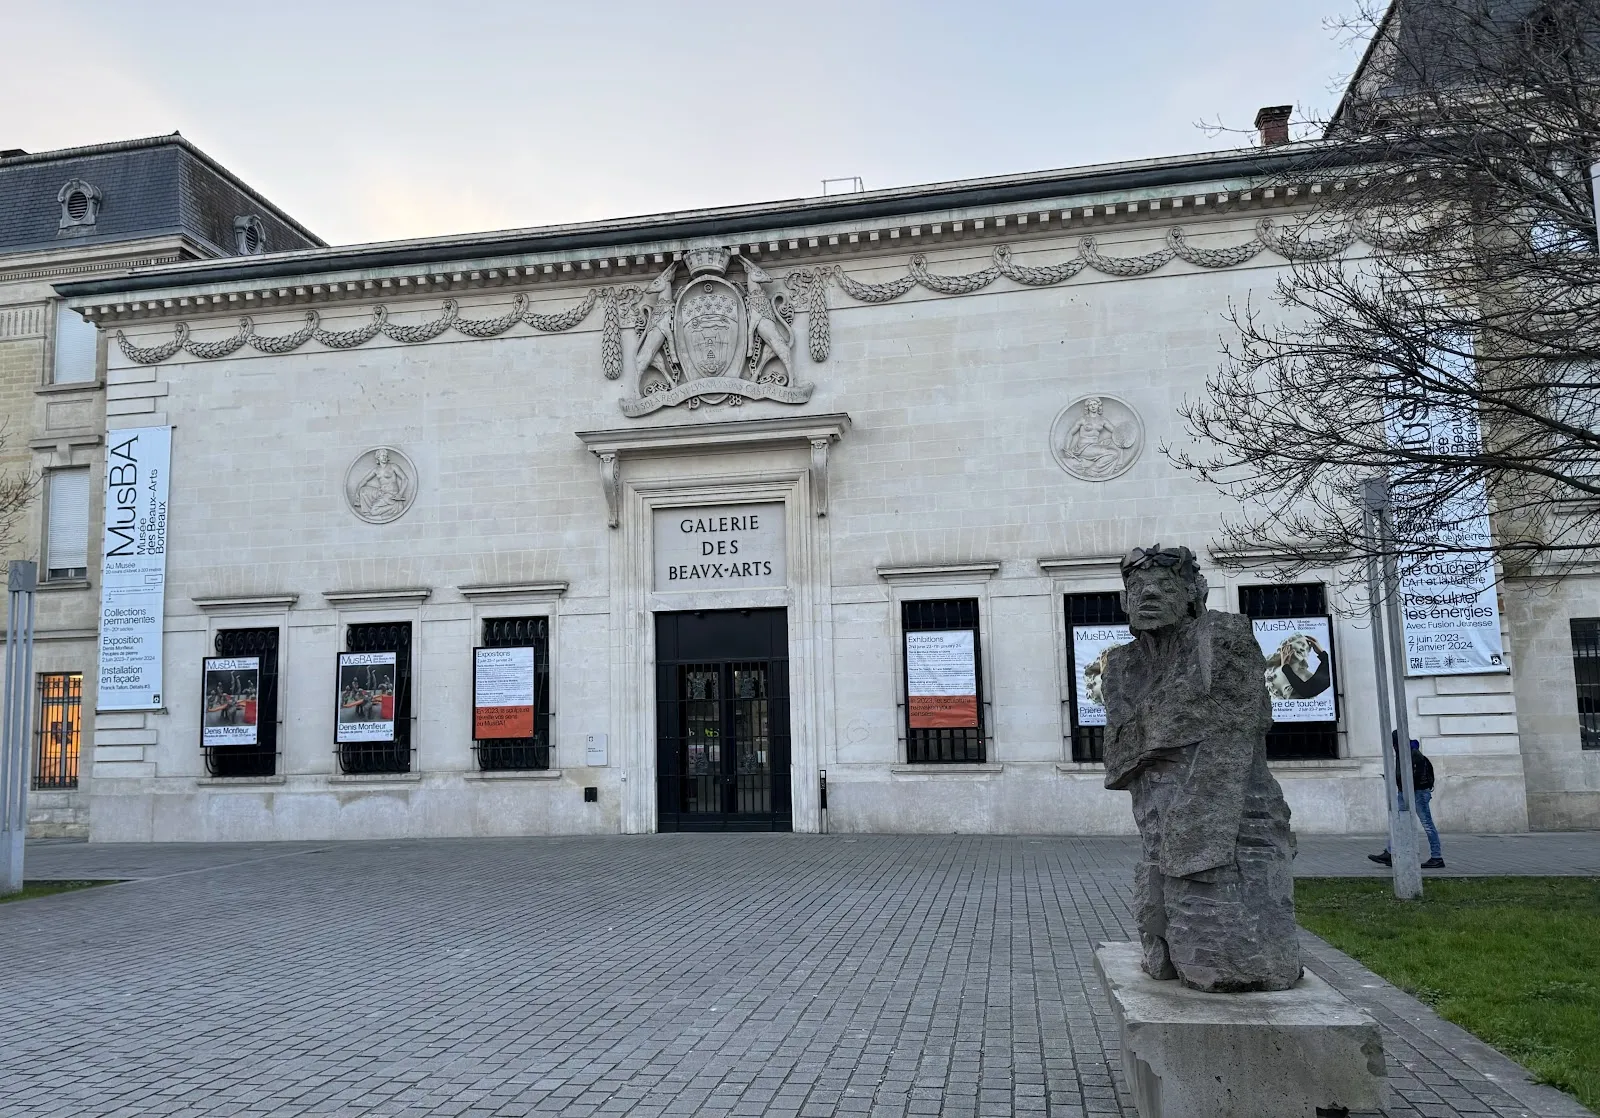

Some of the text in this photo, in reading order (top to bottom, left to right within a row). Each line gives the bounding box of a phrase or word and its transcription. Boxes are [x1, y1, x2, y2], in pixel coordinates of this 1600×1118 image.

[106, 434, 138, 560] MusBA
[146, 468, 158, 555] des Beaux-Arts
[155, 501, 167, 554] Bordeaux
[680, 515, 760, 534] GALERIE
[137, 517, 147, 555] Musée
[702, 540, 739, 555] DES
[1401, 563, 1422, 577] de
[1425, 560, 1480, 576] toucher
[1404, 591, 1479, 606] Resculpter
[104, 608, 146, 616] Collections
[1405, 607, 1427, 620] les
[103, 616, 156, 627] permanentes
[1254, 620, 1297, 632] MusBA
[1406, 619, 1493, 630] Avec Fusion Jeunesse
[103, 635, 144, 646] Exposition
[1075, 630, 1115, 641] MusBA
[1408, 635, 1415, 644] 2
[1416, 634, 1433, 645] juin
[1408, 641, 1474, 654] 7 janvier 2024
[207, 659, 237, 670] MusBA
[341, 654, 372, 664] MusBA
[101, 665, 143, 675] Installation
[101, 674, 141, 685] en façade
[1284, 700, 1295, 708] de
[1296, 699, 1328, 708] toucher
[1080, 706, 1102, 714] Prière
[204, 727, 221, 735] Denis
[338, 722, 387, 731] Denis Monfleur
